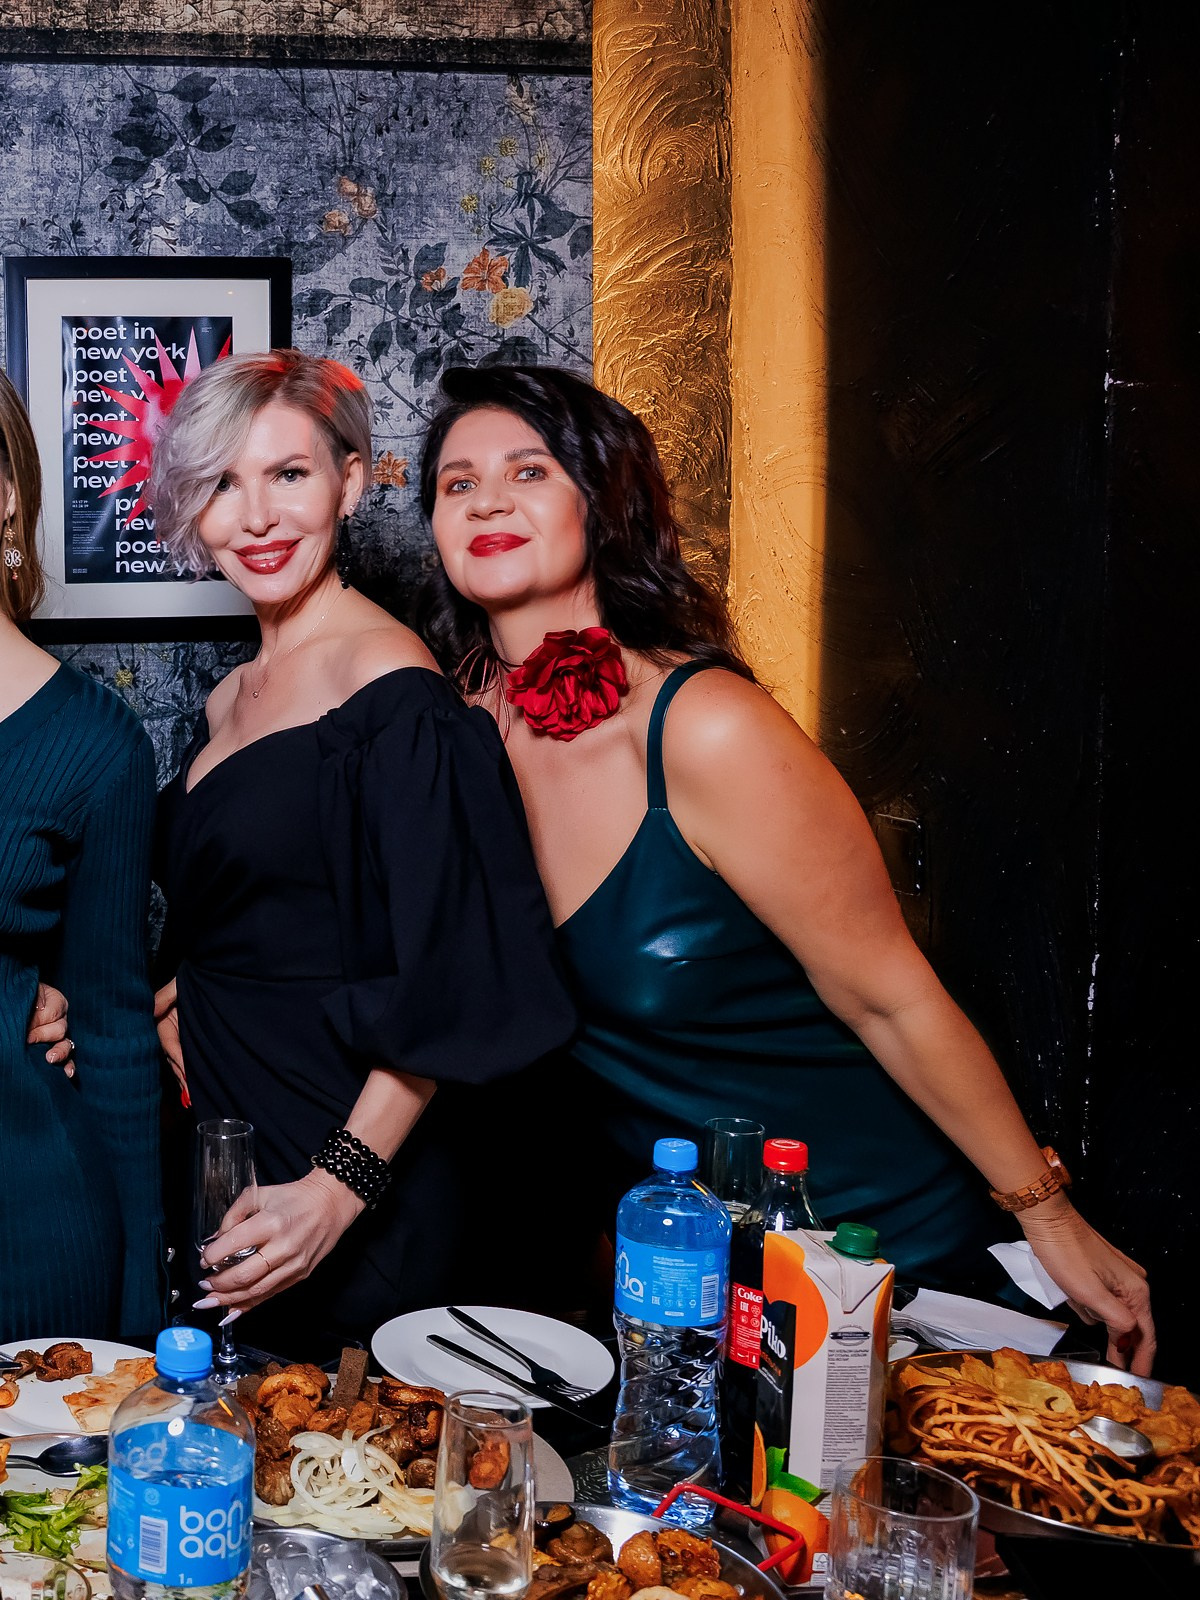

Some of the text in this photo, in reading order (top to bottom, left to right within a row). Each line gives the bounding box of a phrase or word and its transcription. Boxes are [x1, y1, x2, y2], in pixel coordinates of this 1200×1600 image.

[72, 321, 155, 344] poet in
[72, 346, 122, 360] new
[73, 367, 128, 387] poet
[73, 432, 123, 446] new
[115, 560, 166, 573] new
[737, 1287, 763, 1304] Coke
[179, 1500, 244, 1535] bon
